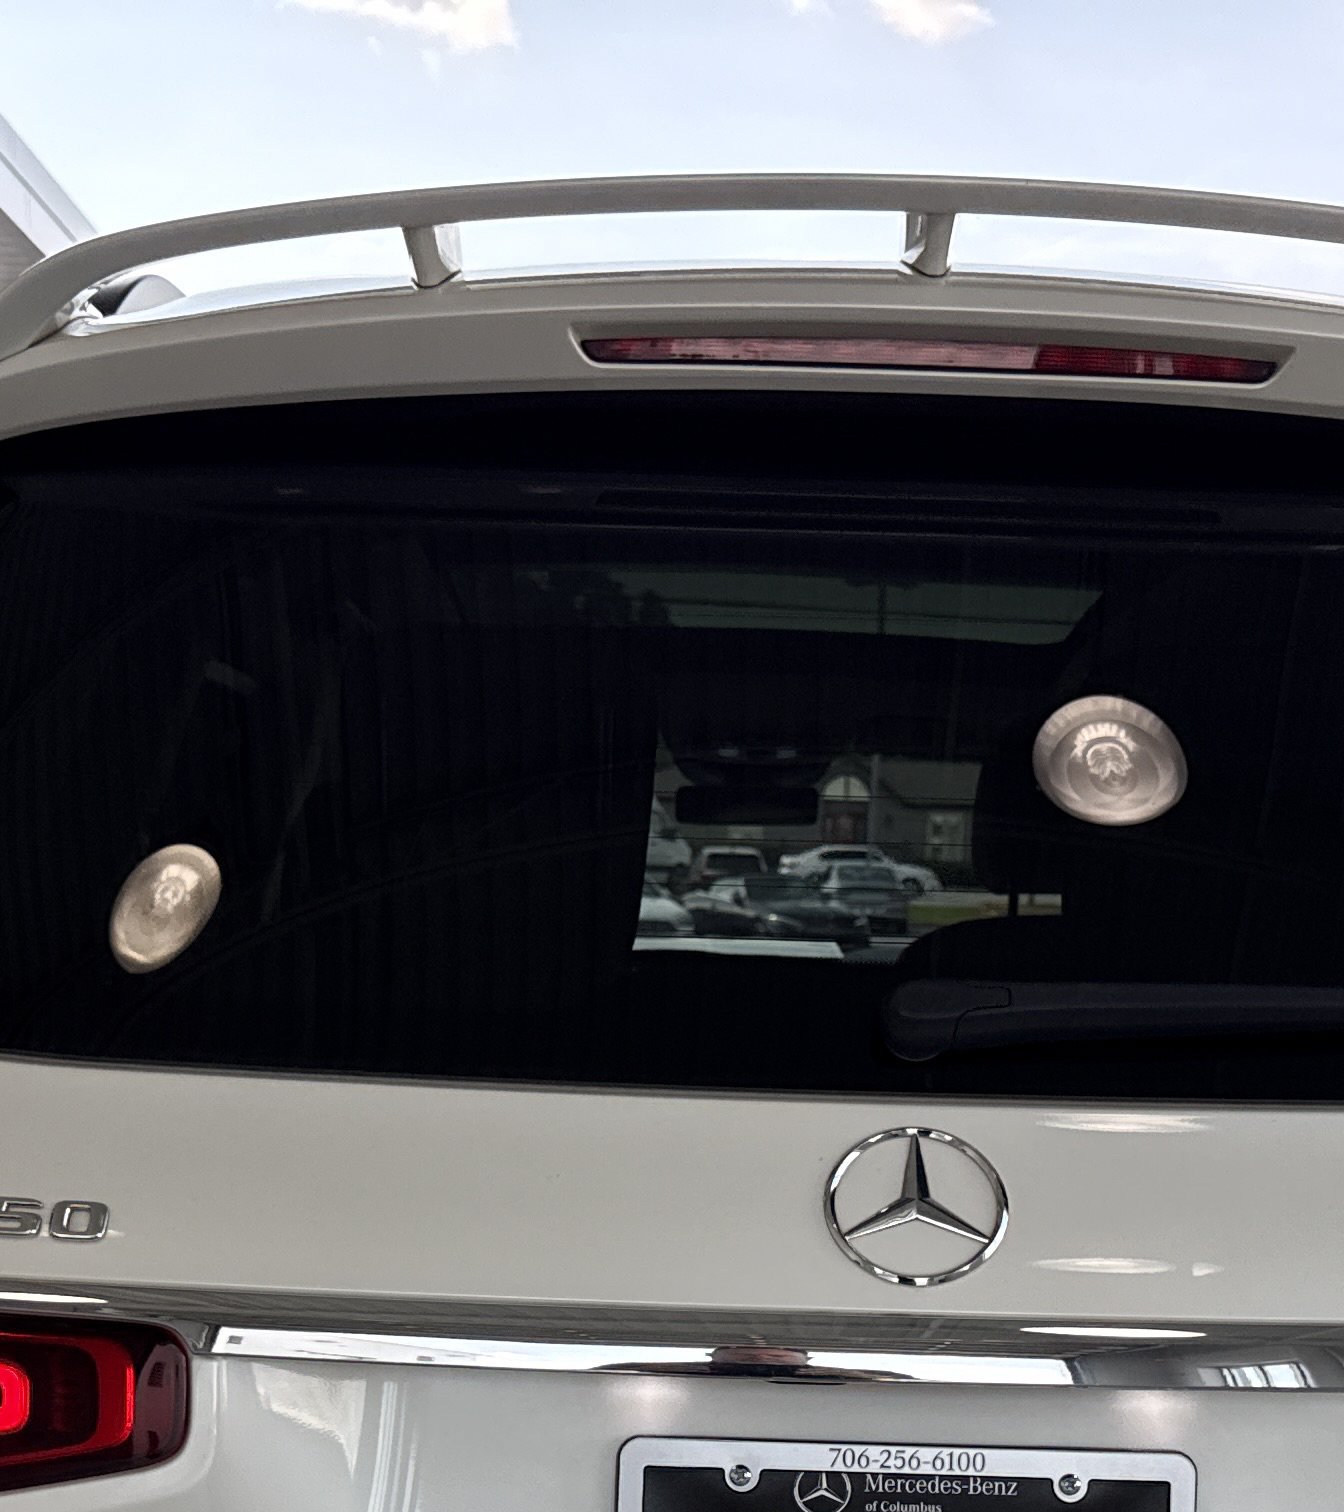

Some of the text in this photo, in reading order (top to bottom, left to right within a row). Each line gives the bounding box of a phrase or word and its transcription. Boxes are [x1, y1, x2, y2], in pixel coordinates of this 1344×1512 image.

[828, 1446, 987, 1474] 706-256-6100
[864, 1473, 1018, 1496] Mercedes-Benz
[865, 1500, 877, 1512] of
